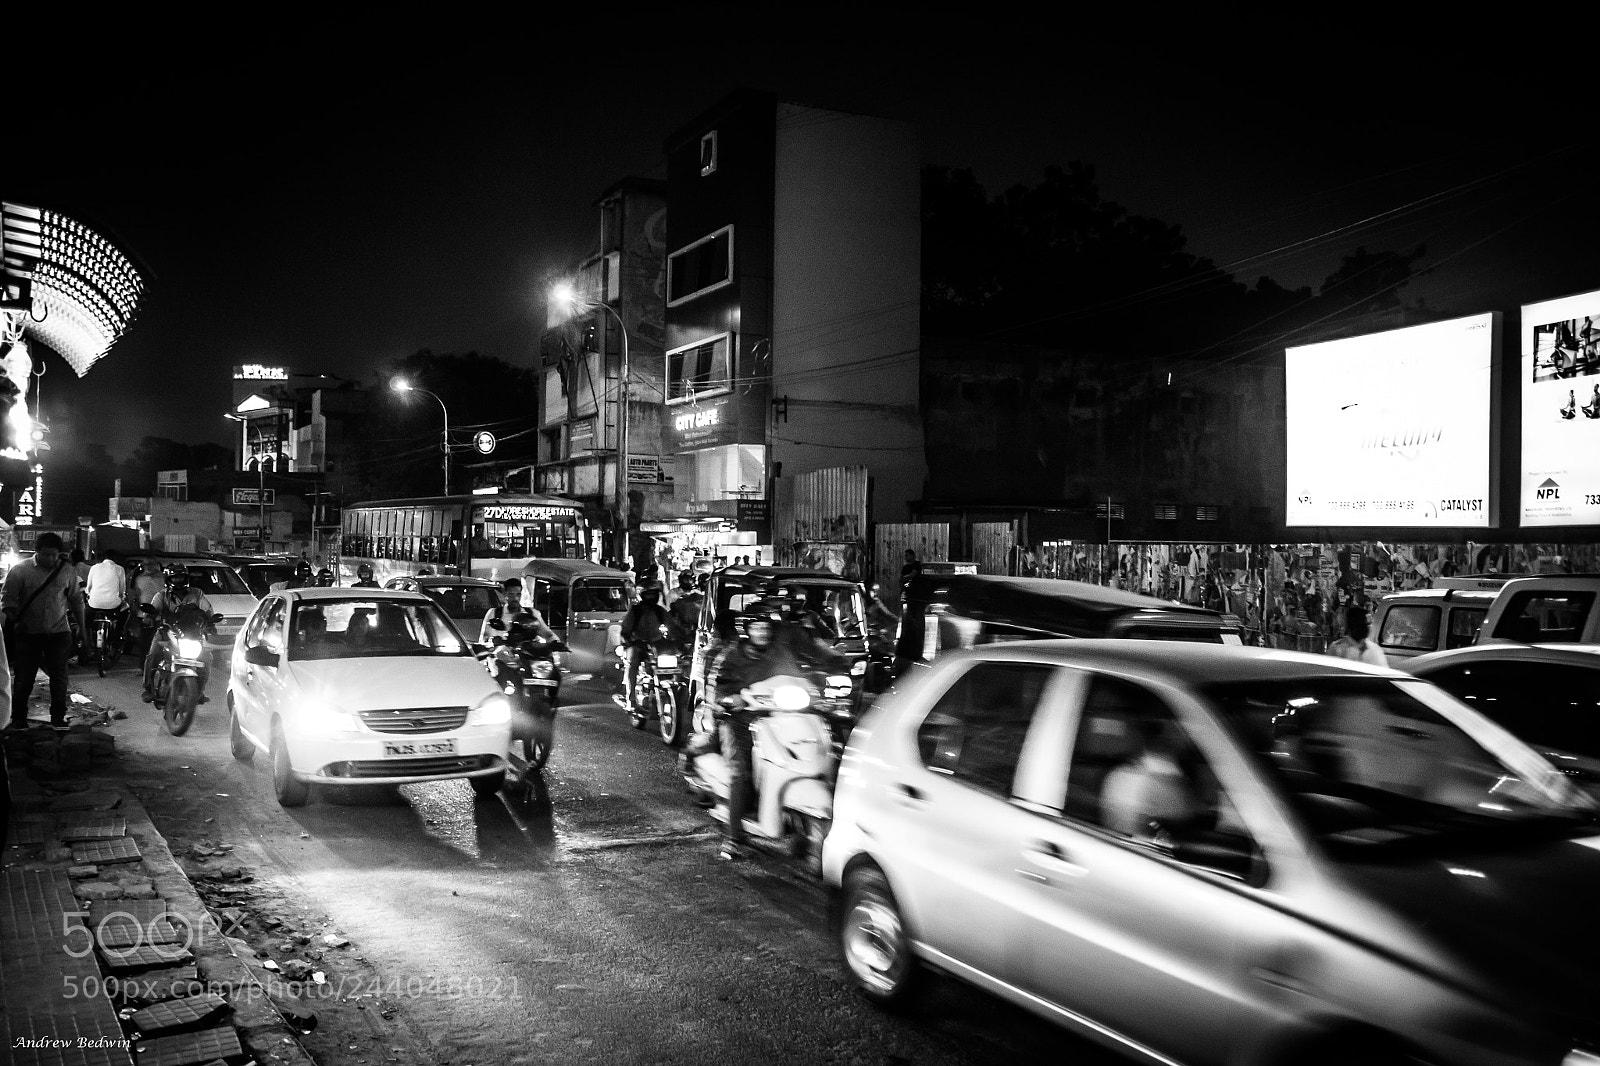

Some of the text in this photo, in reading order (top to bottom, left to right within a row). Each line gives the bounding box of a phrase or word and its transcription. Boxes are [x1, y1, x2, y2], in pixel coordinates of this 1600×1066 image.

[676, 413, 695, 431] CITY
[1537, 488, 1561, 500] NPL
[1441, 498, 1483, 512] CATALYST
[484, 507, 501, 518] 27D
